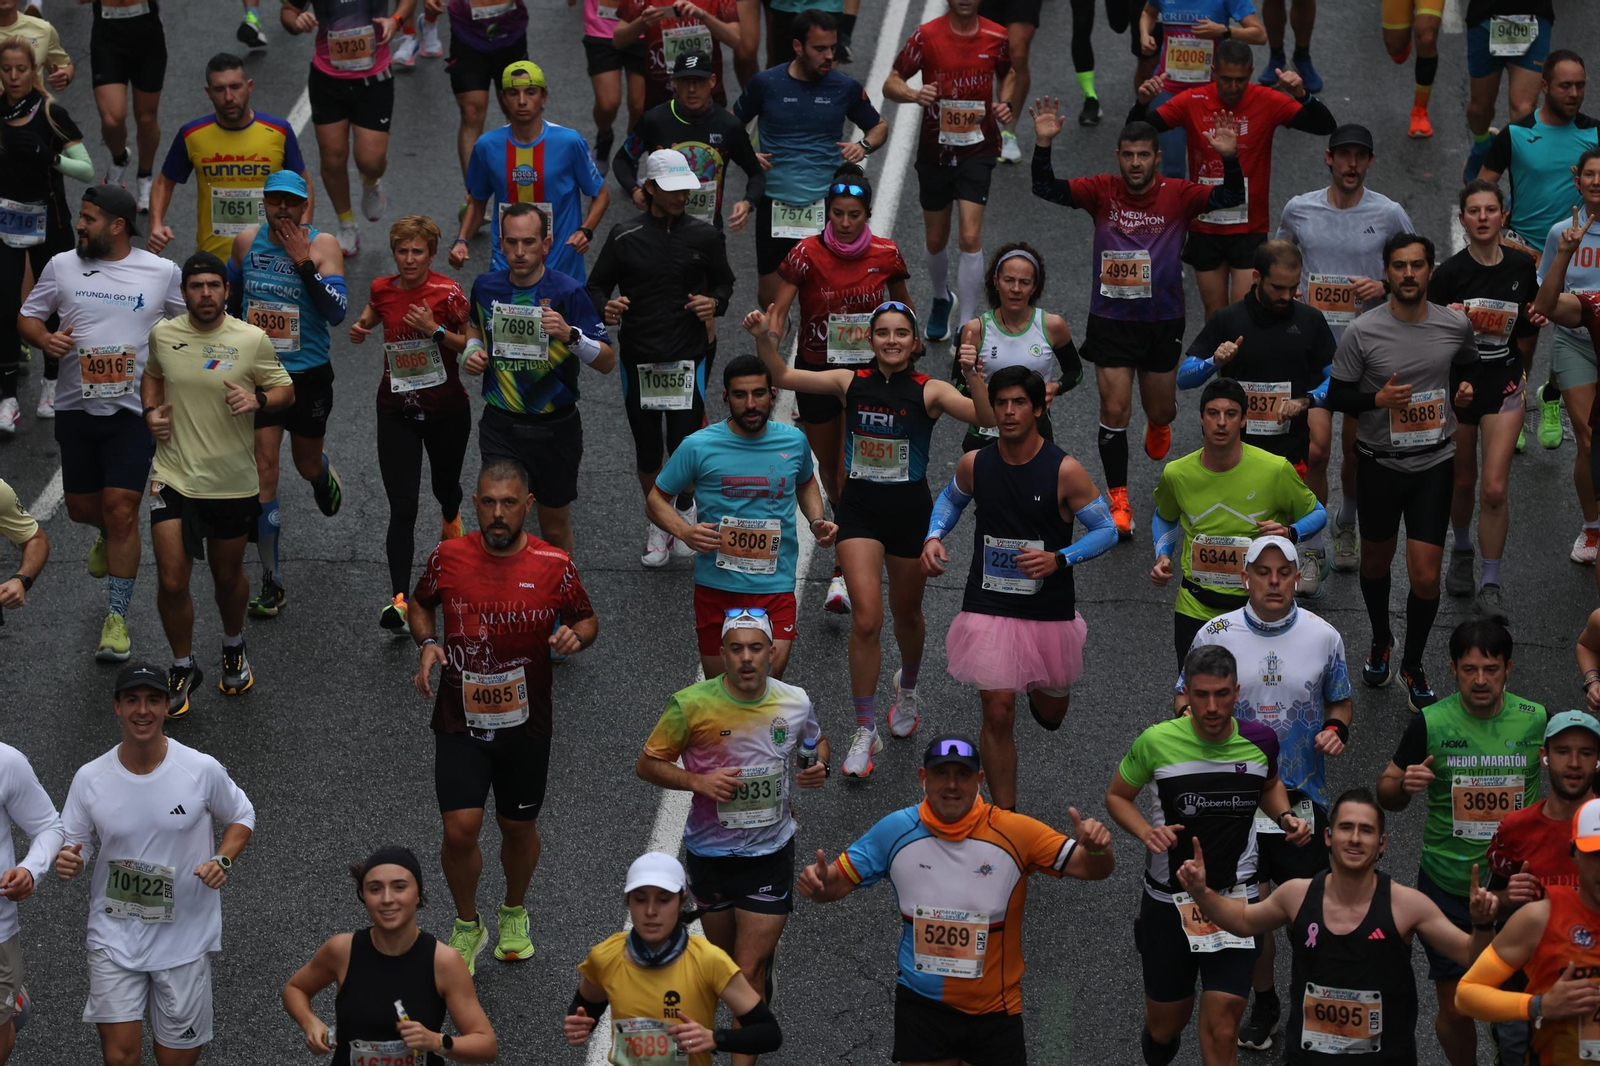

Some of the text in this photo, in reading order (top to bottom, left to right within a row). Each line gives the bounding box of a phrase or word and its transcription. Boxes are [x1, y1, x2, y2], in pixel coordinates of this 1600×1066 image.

[335, 38, 366, 54] 3730
[1170, 48, 1205, 63] 12008
[202, 164, 271, 177] runners
[219, 201, 252, 216] 7651
[780, 208, 813, 222] 7574
[0, 211, 33, 229] 2716
[1106, 263, 1138, 278] 4994
[75, 290, 112, 300] HYUNDAI
[244, 279, 302, 299] ATLETISMO
[1315, 287, 1350, 303] 6250
[253, 312, 286, 330] 3930
[501, 318, 535, 336] 7698
[1471, 310, 1503, 328] 4764
[837, 325, 872, 342] 7104
[88, 358, 123, 375] 4916
[644, 372, 685, 389] 10355
[1246, 395, 1277, 412] 837
[857, 410, 894, 428] TRI
[1400, 405, 1436, 423] 3688
[860, 440, 893, 459] 9251
[728, 530, 767, 549] 3608
[1199, 548, 1238, 565] 6344
[472, 685, 513, 705] 4085
[1518, 703, 1536, 713] 2023
[1441, 740, 1469, 748] HOKA
[1447, 752, 1527, 767] MEDIO MARATÓN
[1196, 795, 1257, 811] Roberto Ramos
[1463, 791, 1509, 811] 3696
[112, 869, 165, 897] 10122
[924, 924, 970, 947] 5269
[1315, 1003, 1363, 1027] 6095
[624, 1034, 669, 1059] 7689
